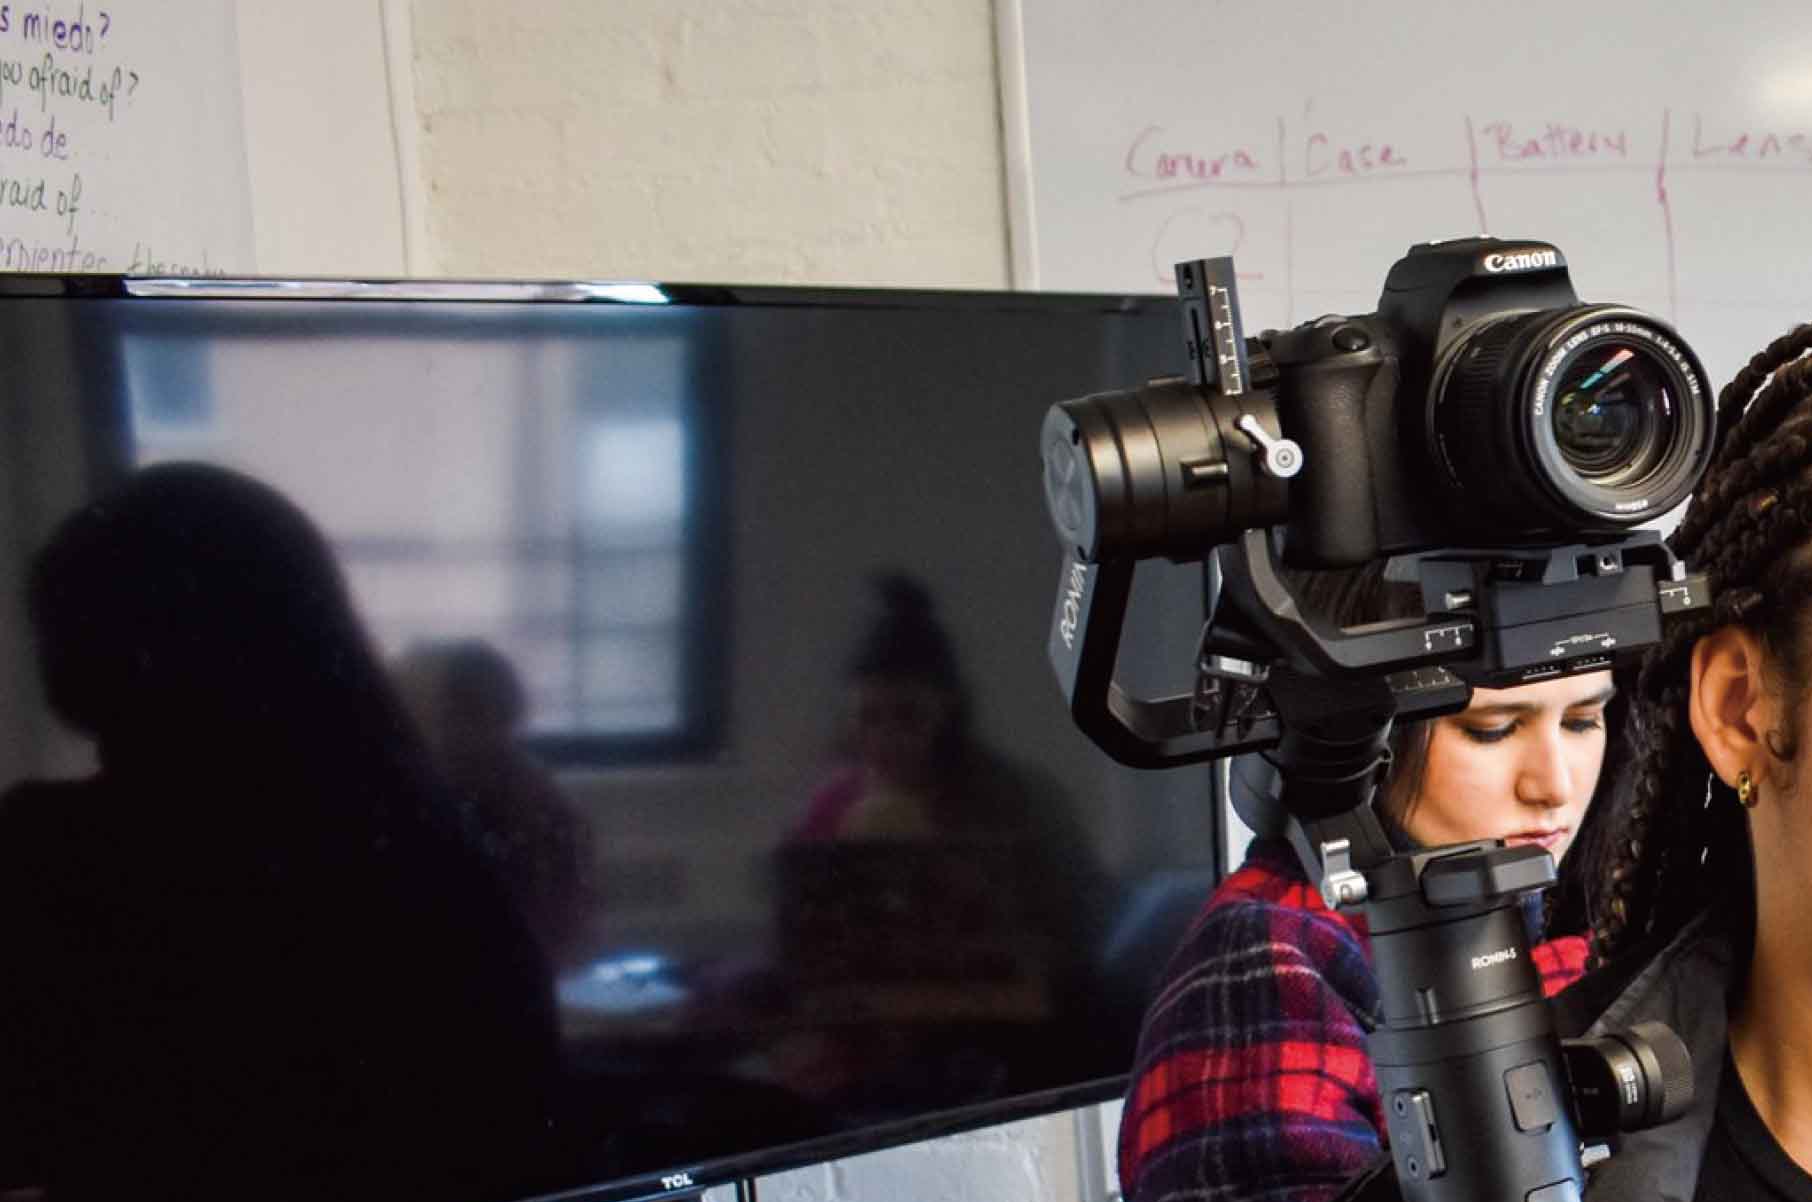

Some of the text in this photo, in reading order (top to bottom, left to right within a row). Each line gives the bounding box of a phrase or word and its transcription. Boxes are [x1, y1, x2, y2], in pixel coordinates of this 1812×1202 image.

[29, 51, 95, 112] afraid
[1125, 124, 1258, 178] Camera
[1305, 134, 1407, 177] Case
[1481, 122, 1628, 162] Battery
[1484, 250, 1557, 273] Canon
[661, 1172, 694, 1191] TCL
